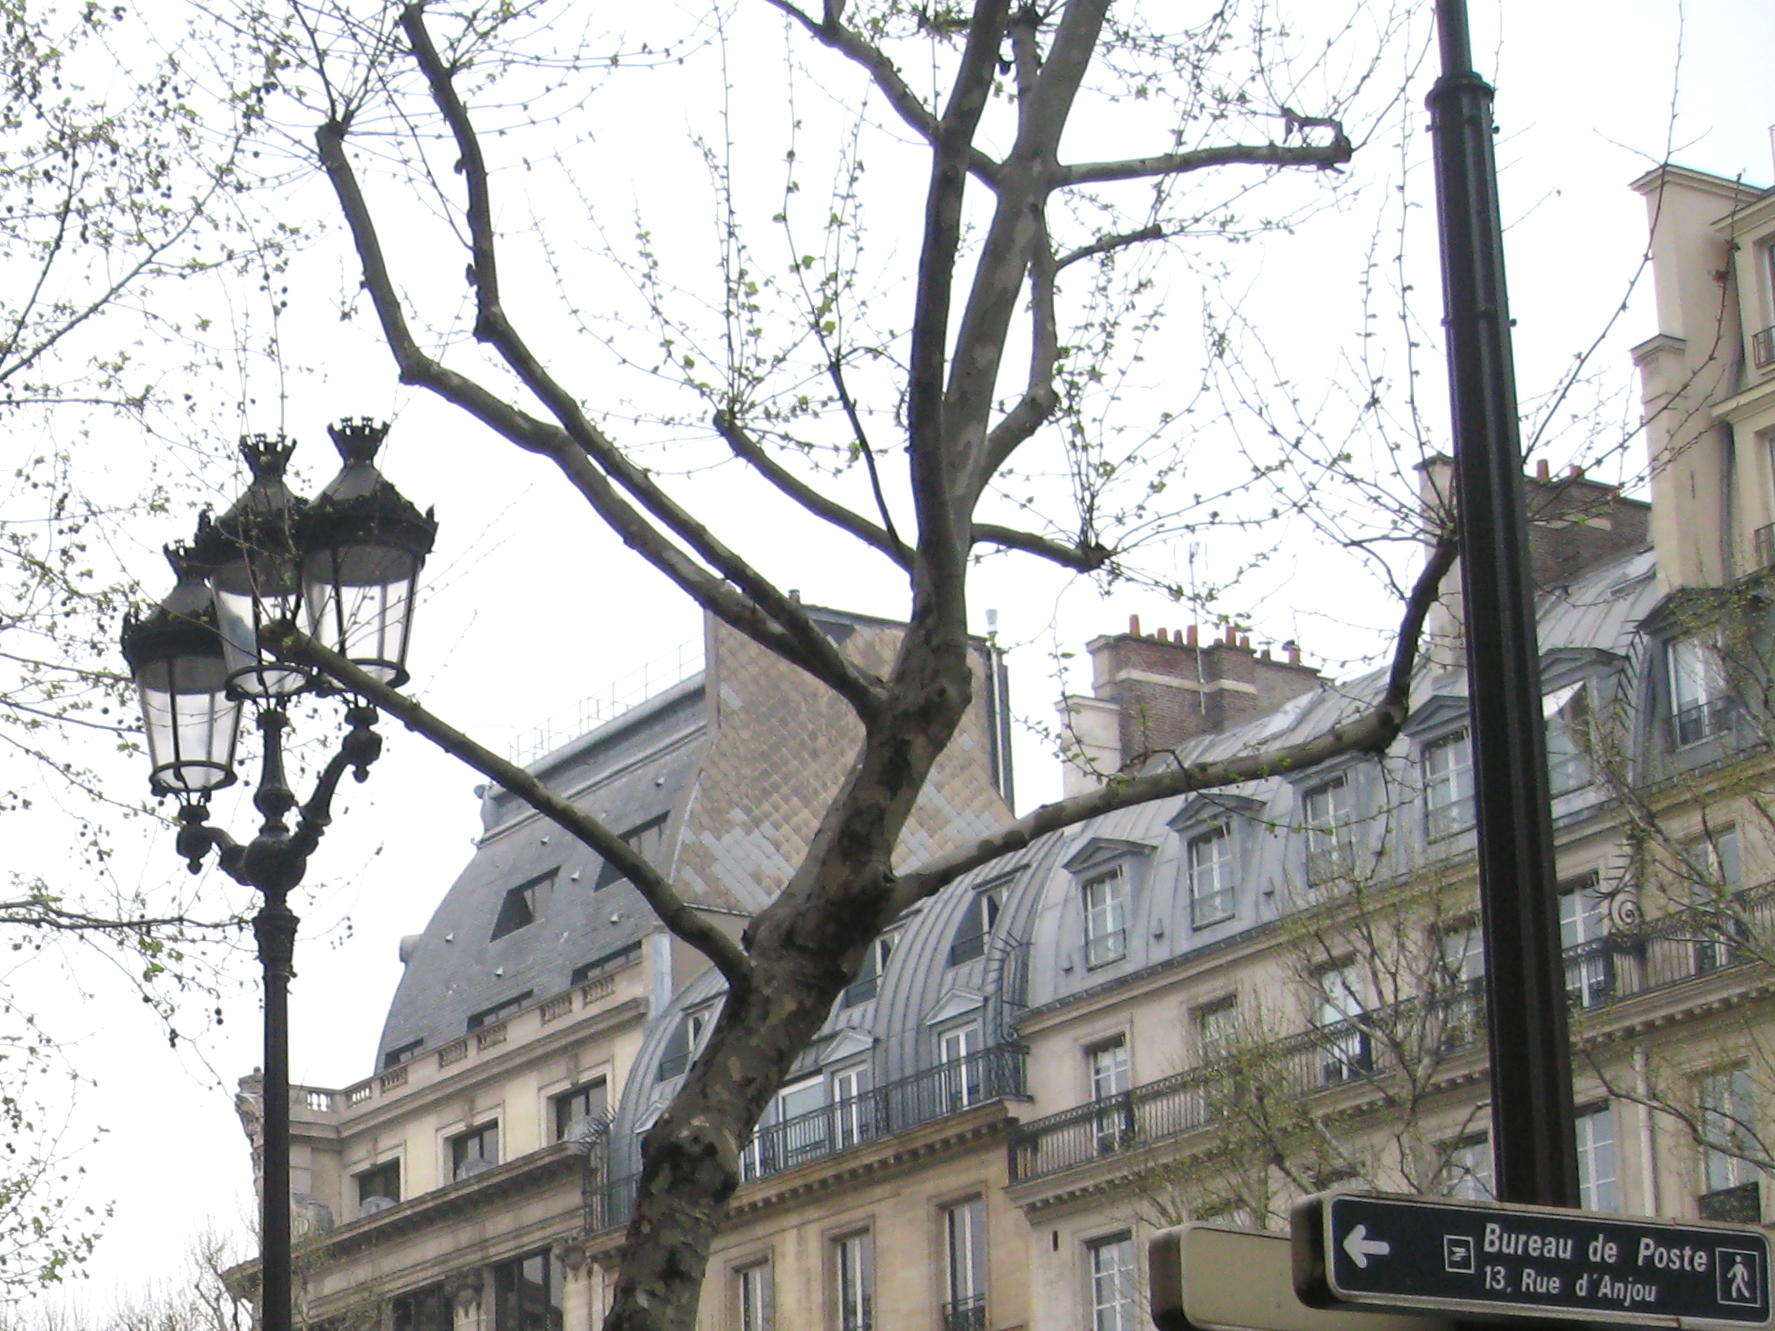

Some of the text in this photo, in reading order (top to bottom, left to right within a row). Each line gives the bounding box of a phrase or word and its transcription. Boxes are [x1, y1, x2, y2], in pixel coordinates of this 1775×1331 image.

[1483, 1222, 1708, 1273] Bureau de Poste
[1521, 1268, 1561, 1295] Rue
[1575, 1272, 1657, 1307] d'Anjou
